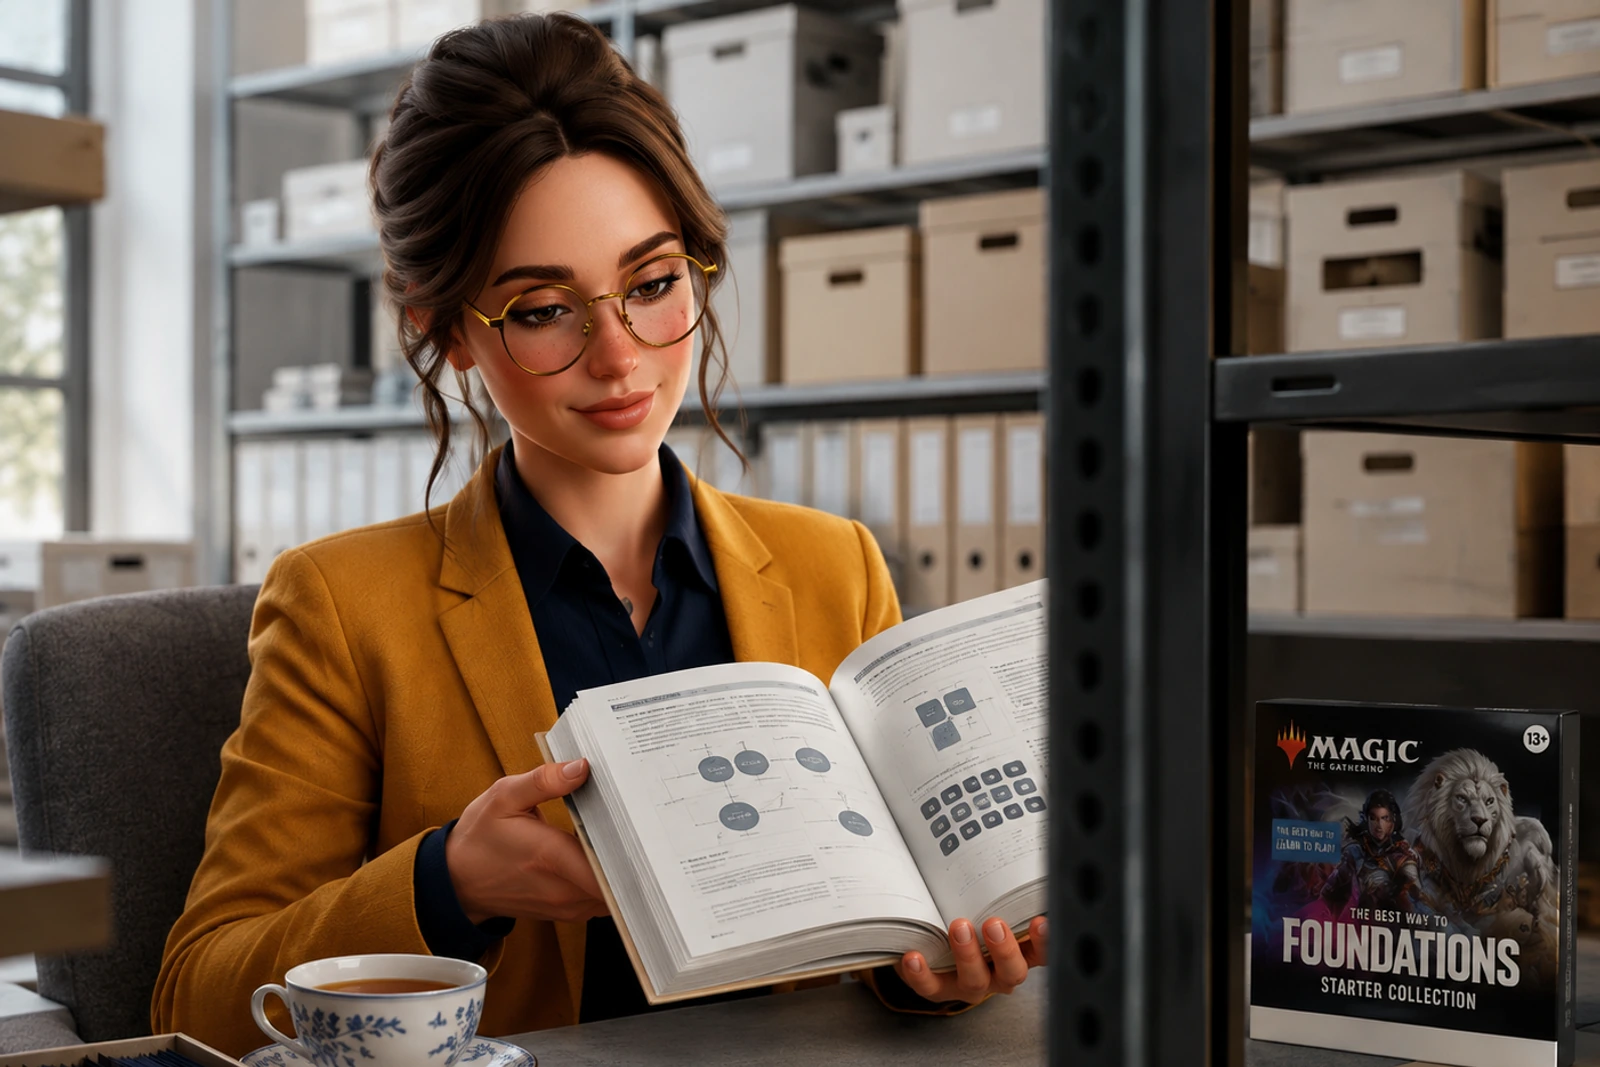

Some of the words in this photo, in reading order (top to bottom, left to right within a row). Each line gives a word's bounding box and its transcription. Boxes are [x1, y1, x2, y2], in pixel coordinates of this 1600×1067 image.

[1527, 732, 1548, 746] 13+
[1307, 735, 1420, 765] MAGIC
[1307, 761, 1325, 770] THE
[1329, 763, 1384, 774] GATHERING
[1303, 841, 1313, 852] TO
[1350, 907, 1370, 921] THE
[1374, 909, 1401, 924] BEST
[1405, 911, 1429, 926] WAY
[1434, 915, 1448, 928] TO
[1282, 917, 1520, 988] FOUNDATIONS
[1321, 976, 1382, 999] STARTER
[1388, 983, 1476, 1010] COLLECTION
